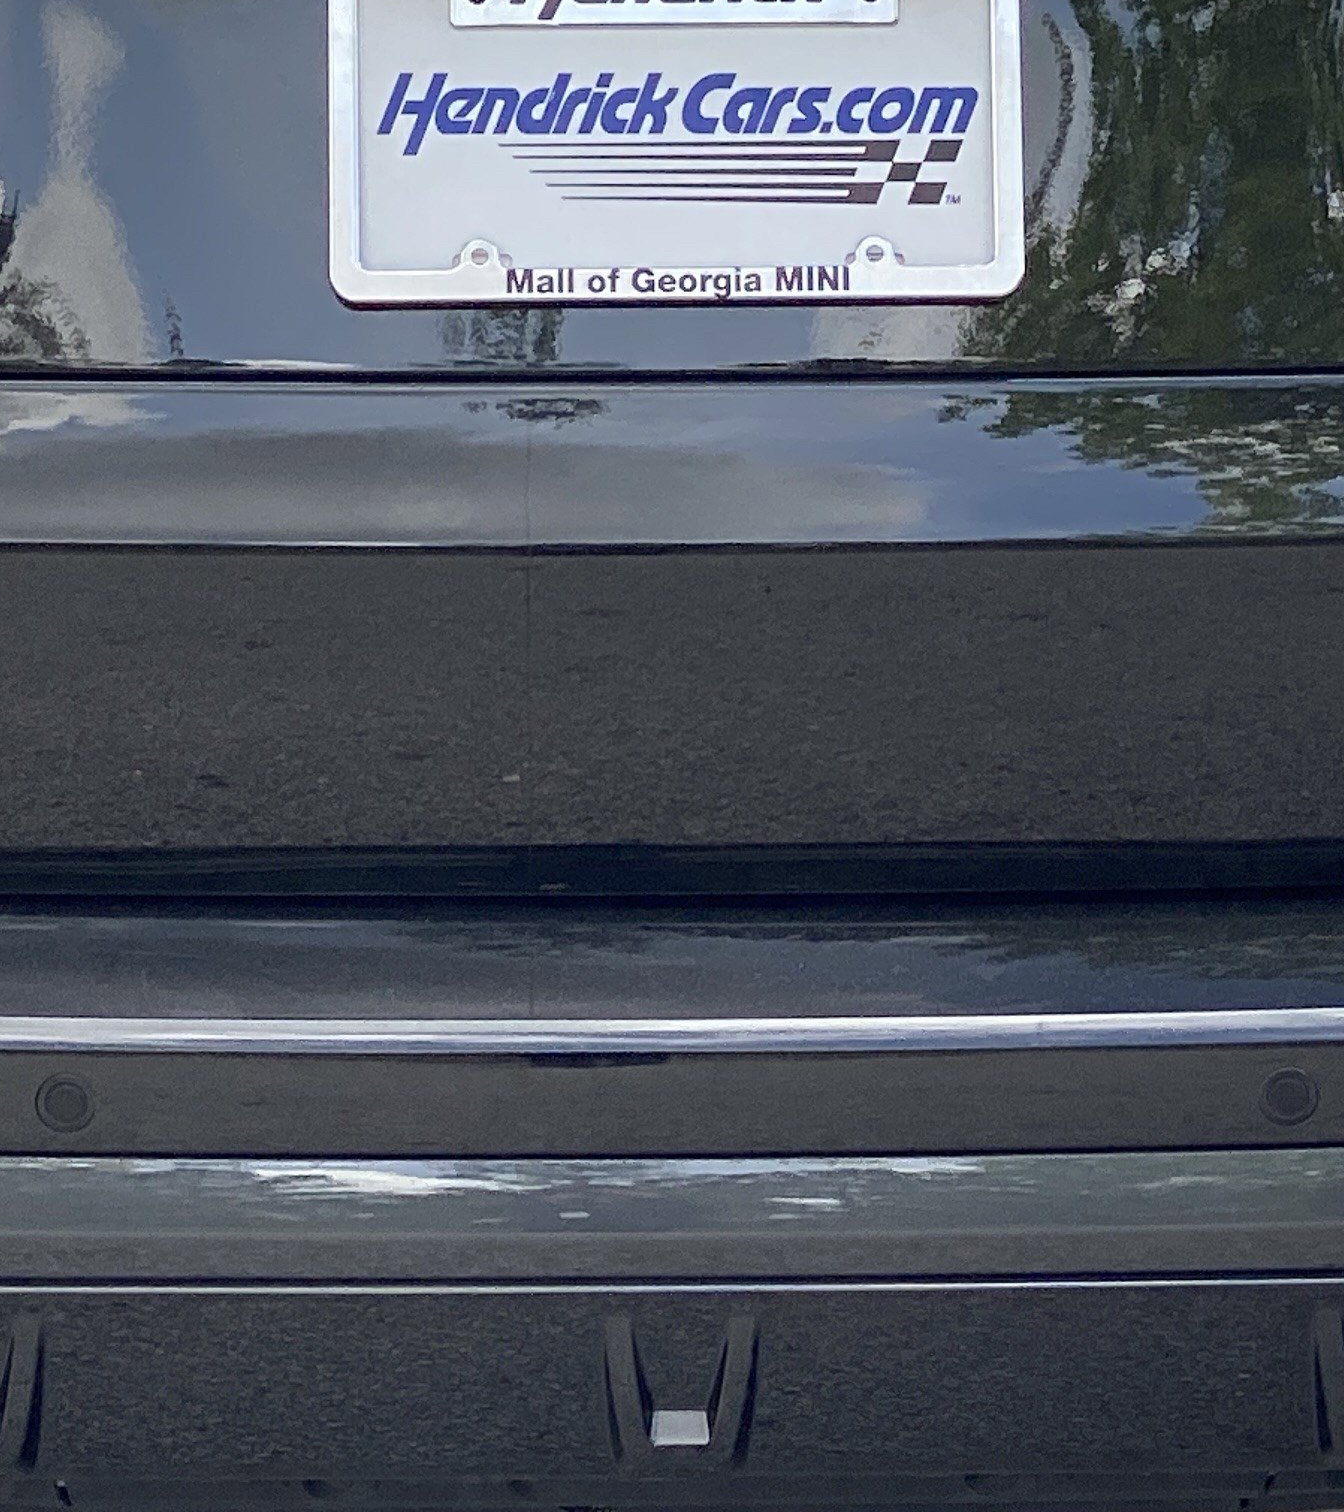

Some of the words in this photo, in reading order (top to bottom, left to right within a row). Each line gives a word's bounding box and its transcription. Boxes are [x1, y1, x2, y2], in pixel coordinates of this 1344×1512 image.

[506, 267, 575, 294] Mall
[587, 267, 621, 294] of
[631, 266, 762, 300] Georgia
[775, 265, 851, 292] MINI
